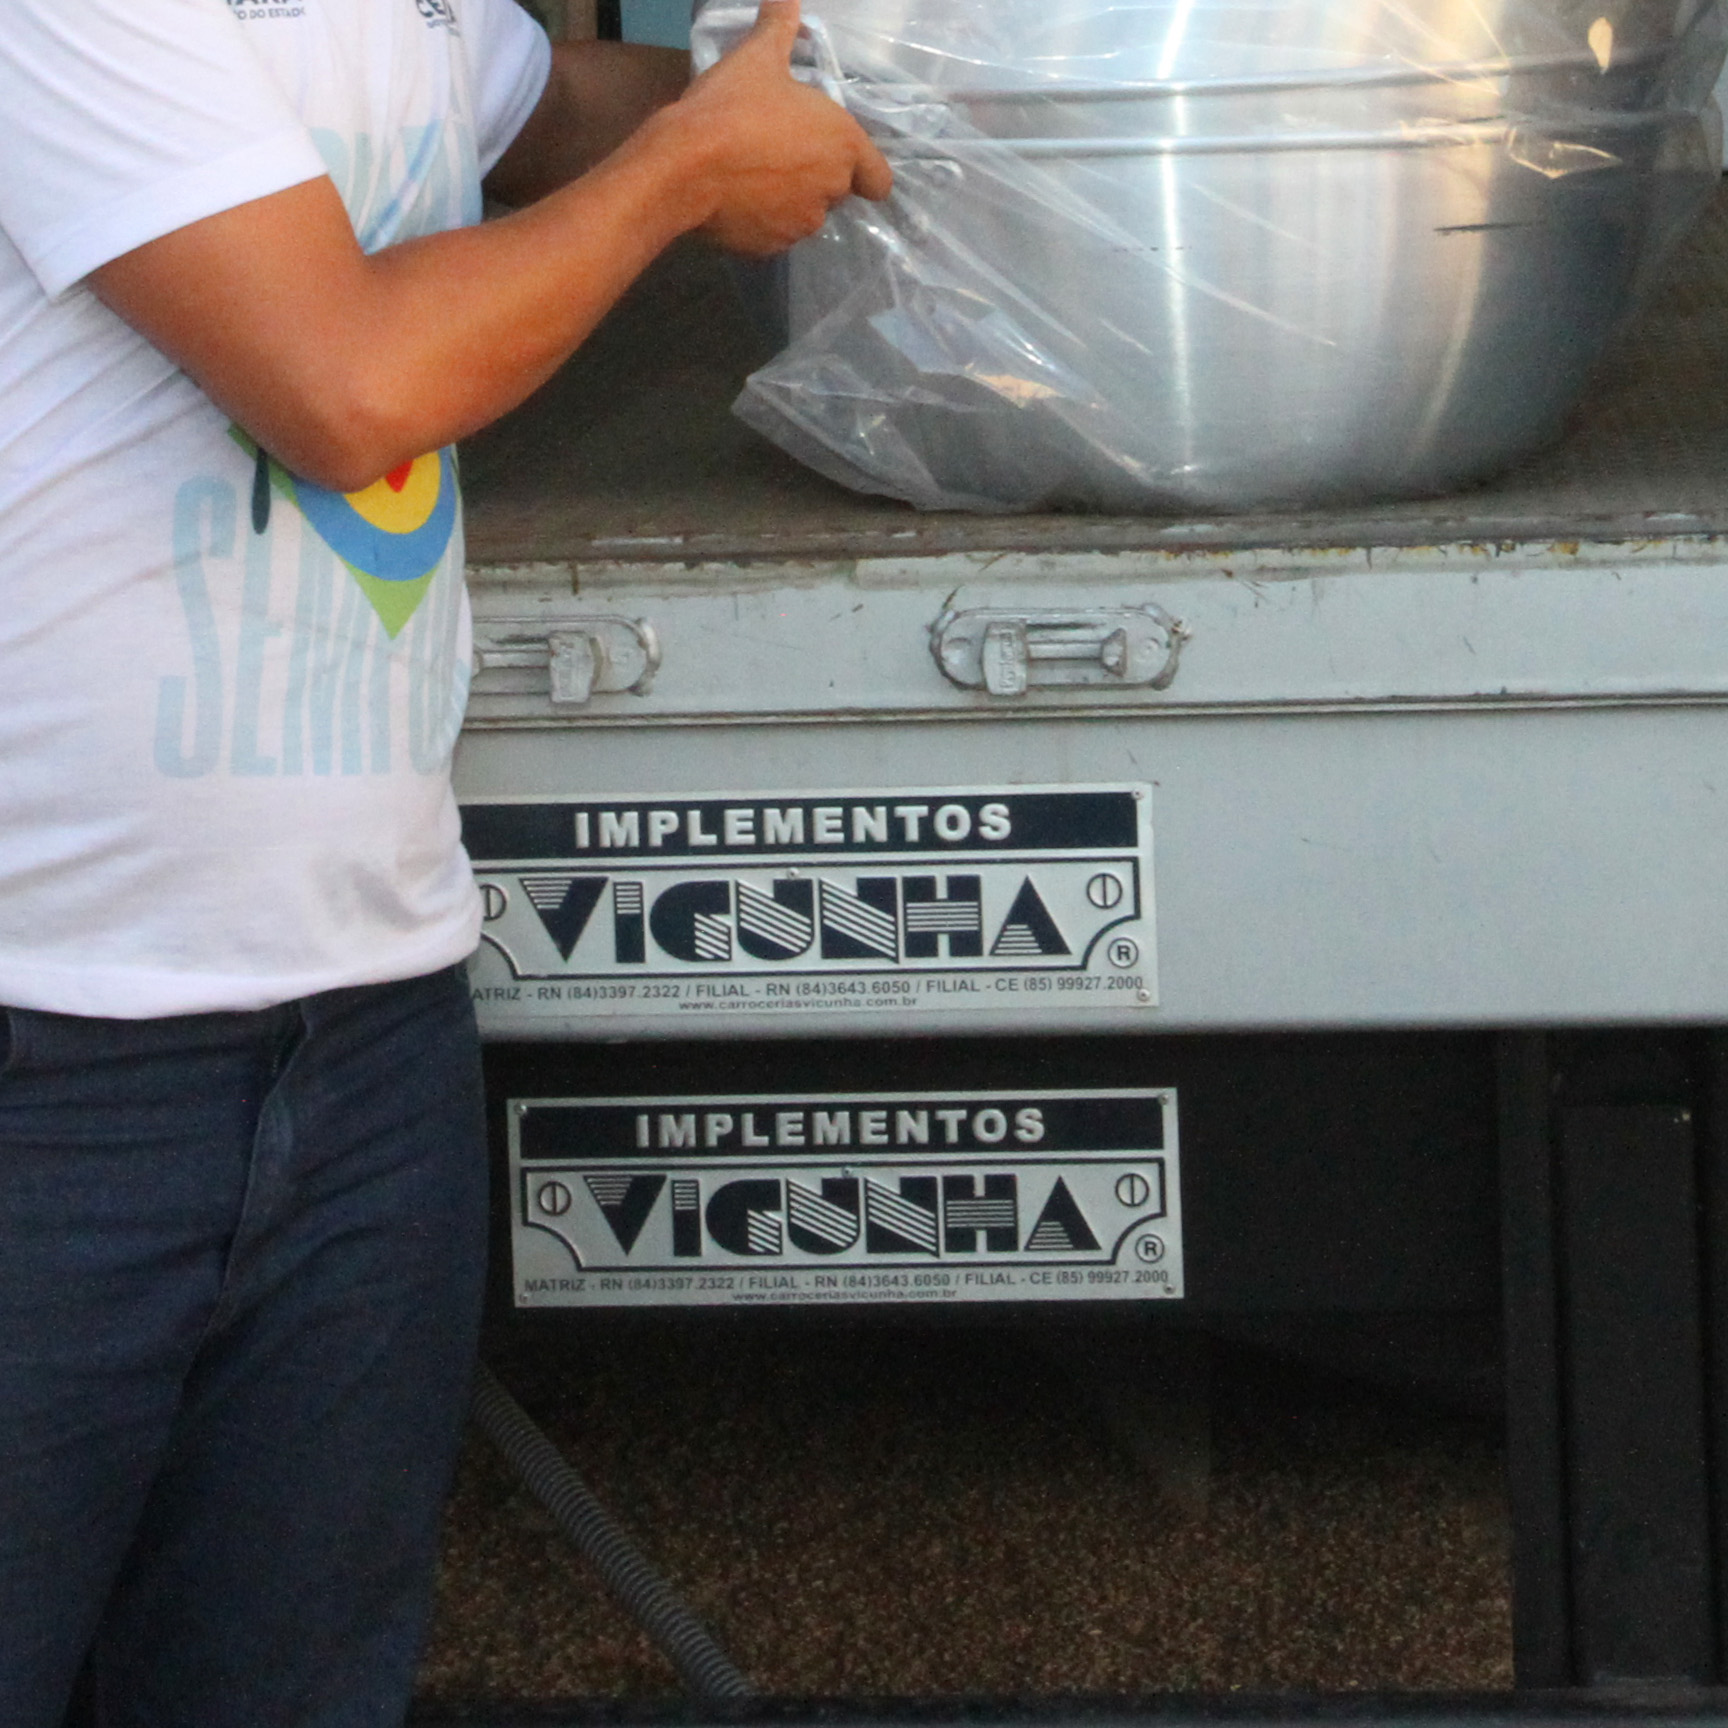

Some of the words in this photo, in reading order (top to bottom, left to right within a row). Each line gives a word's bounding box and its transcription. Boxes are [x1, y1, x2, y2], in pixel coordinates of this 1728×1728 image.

[575, 803, 1013, 850] IMPLEMENTOS
[519, 874, 1073, 964] VICUNHA
[472, 986, 522, 1002] ATRIZ
[538, 986, 562, 1001] RN
[568, 984, 681, 1001] (84)3397.2322
[696, 983, 749, 998] FILIAL
[767, 983, 790, 997] RN
[796, 980, 910, 996] (84)3643.6050
[927, 978, 977, 993] FILIAL
[995, 977, 1019, 992] CE
[1024, 976, 1053, 993] (85)
[1057, 975, 1143, 991] 99927.2000
[636, 1108, 1045, 1149] IMPLEMENTOS
[583, 1174, 1102, 1258] VICUNHA
[524, 1277, 585, 1292] MATRIZ
[600, 1277, 622, 1291] RN
[749, 1276, 798, 1290] FILIAL
[815, 1275, 837, 1289] RN
[965, 1272, 1015, 1286] FILIAL
[1030, 1271, 1052, 1286] CE
[1056, 1270, 1083, 1286] (85)
